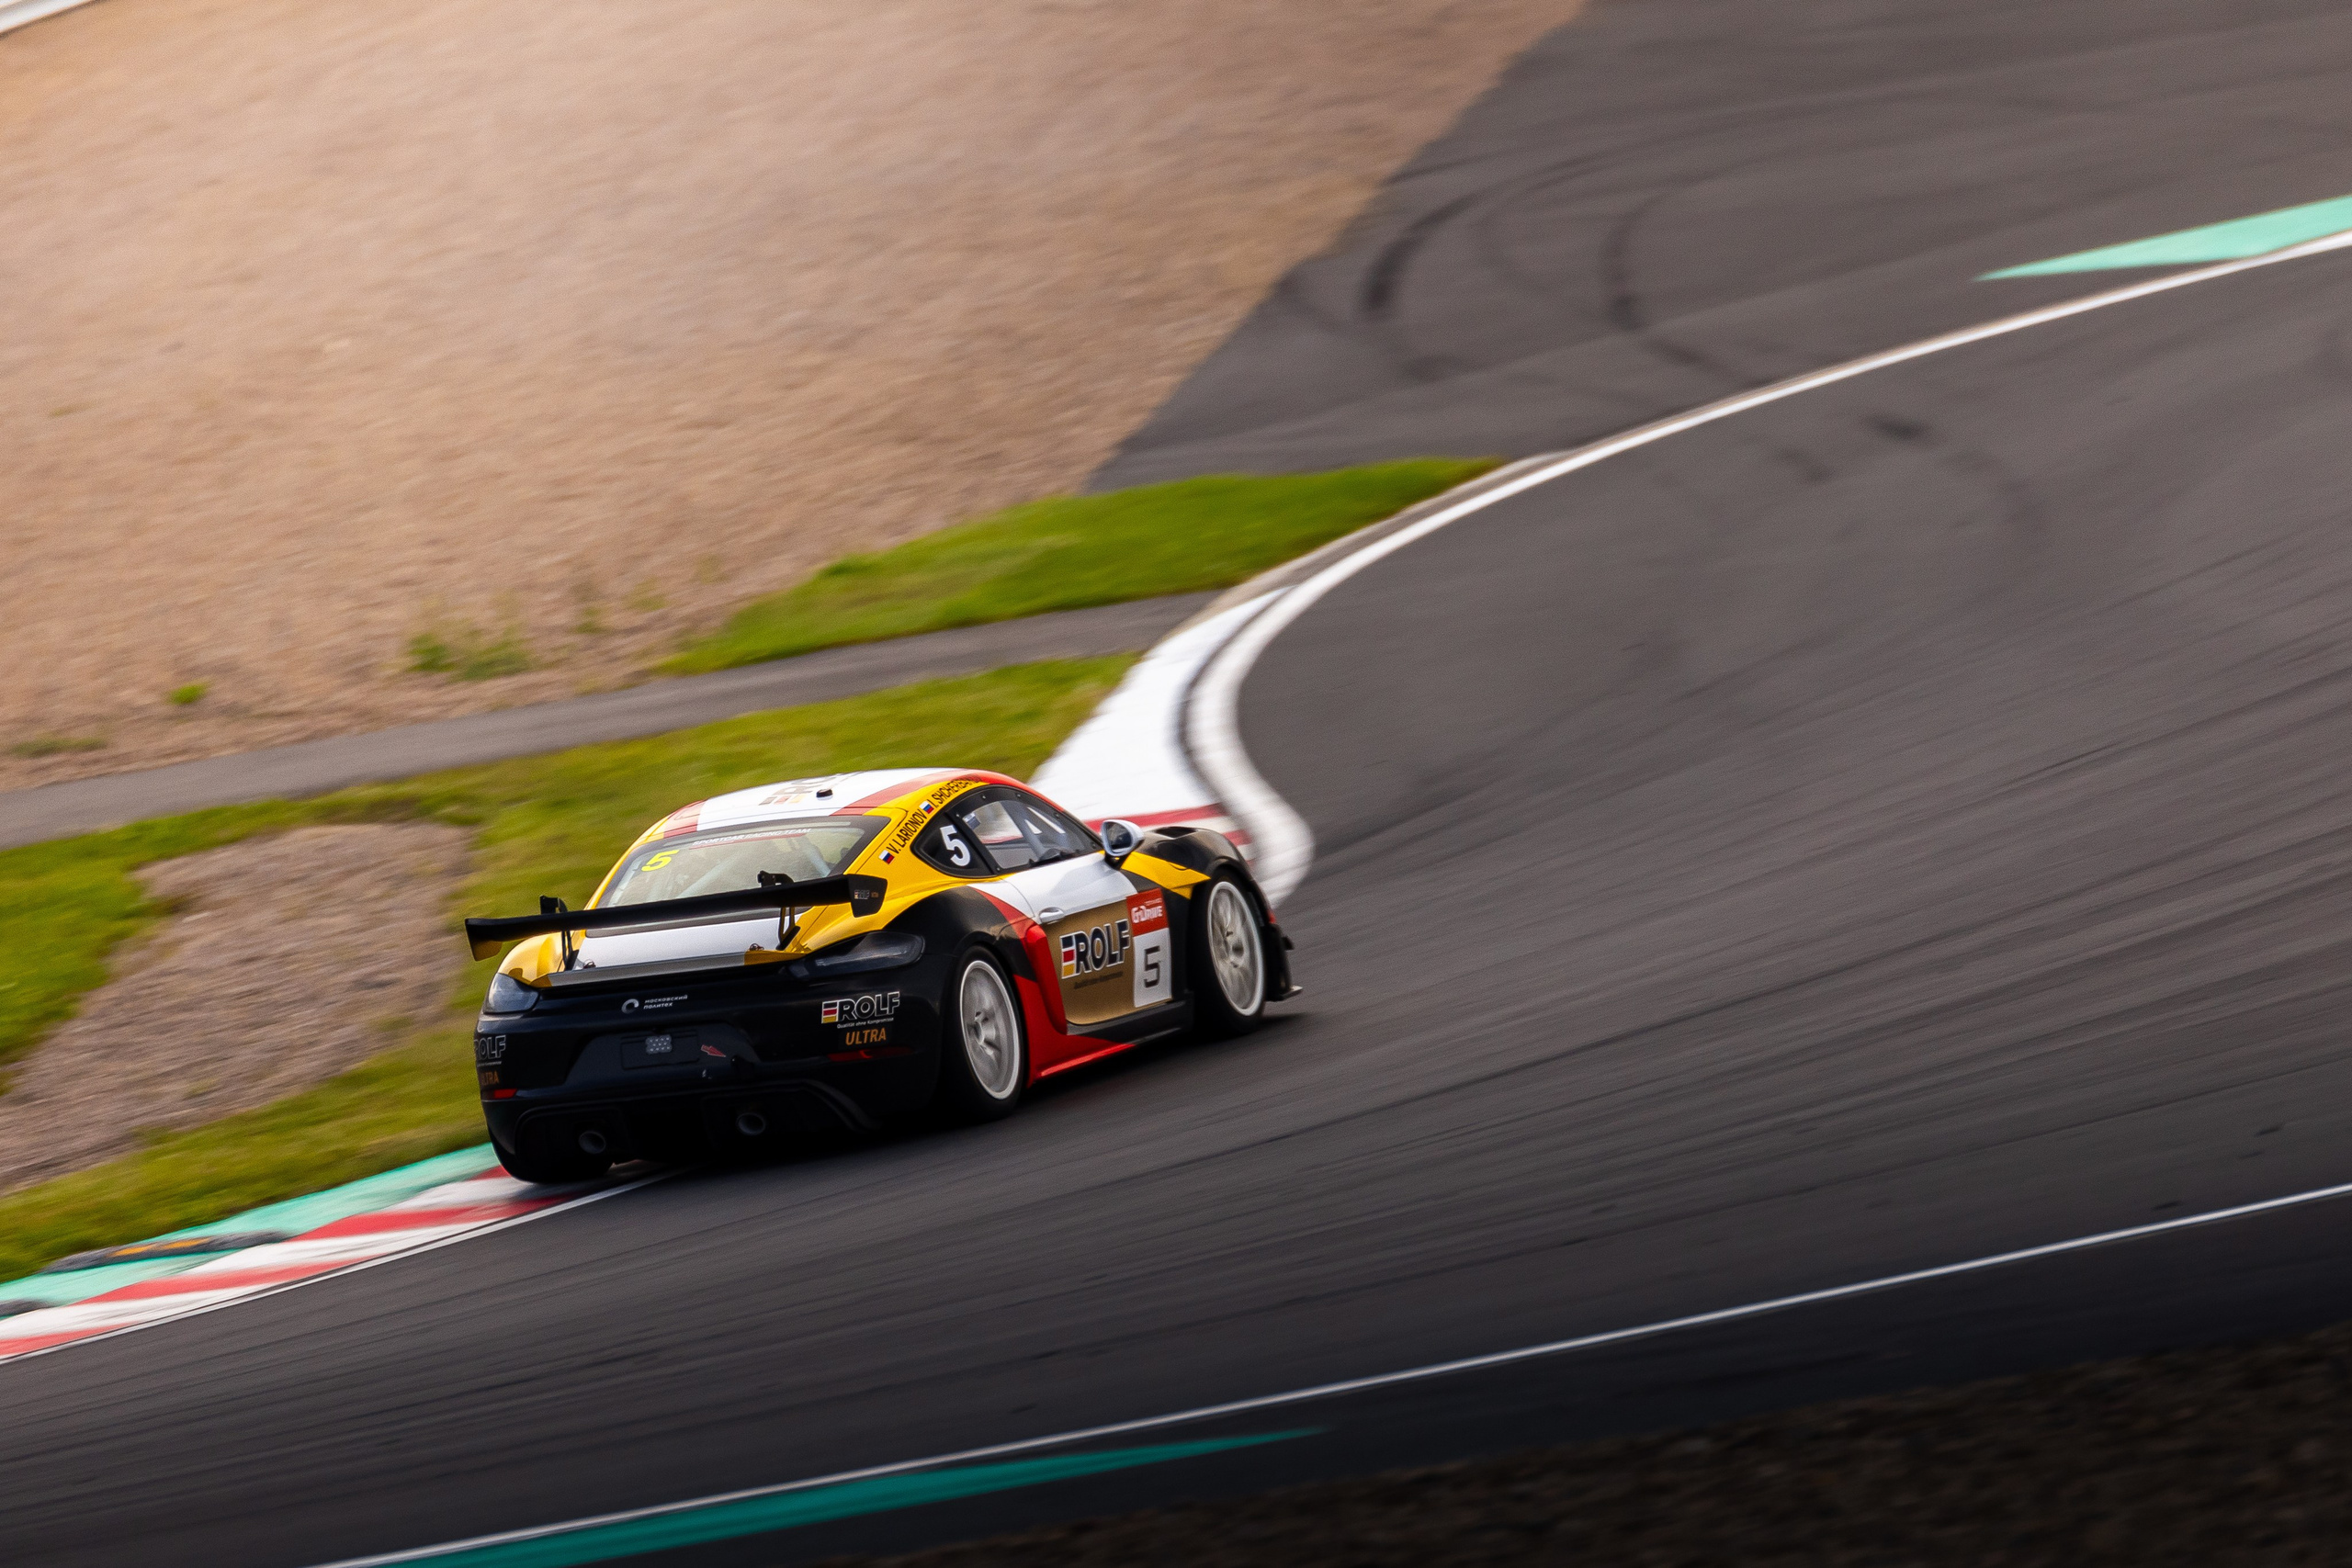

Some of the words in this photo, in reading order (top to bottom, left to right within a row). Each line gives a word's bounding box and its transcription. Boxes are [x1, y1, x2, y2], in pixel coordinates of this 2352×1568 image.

[692, 834, 745, 846] SPORTCAR
[892, 808, 928, 848] LARIONOV
[641, 849, 680, 872] 5
[886, 843, 901, 854] V.
[940, 824, 971, 867] 5
[1073, 919, 1130, 975] ROLF
[1143, 945, 1160, 988] 5
[837, 991, 900, 1021] ROLF
[845, 1027, 887, 1046] ULTRA
